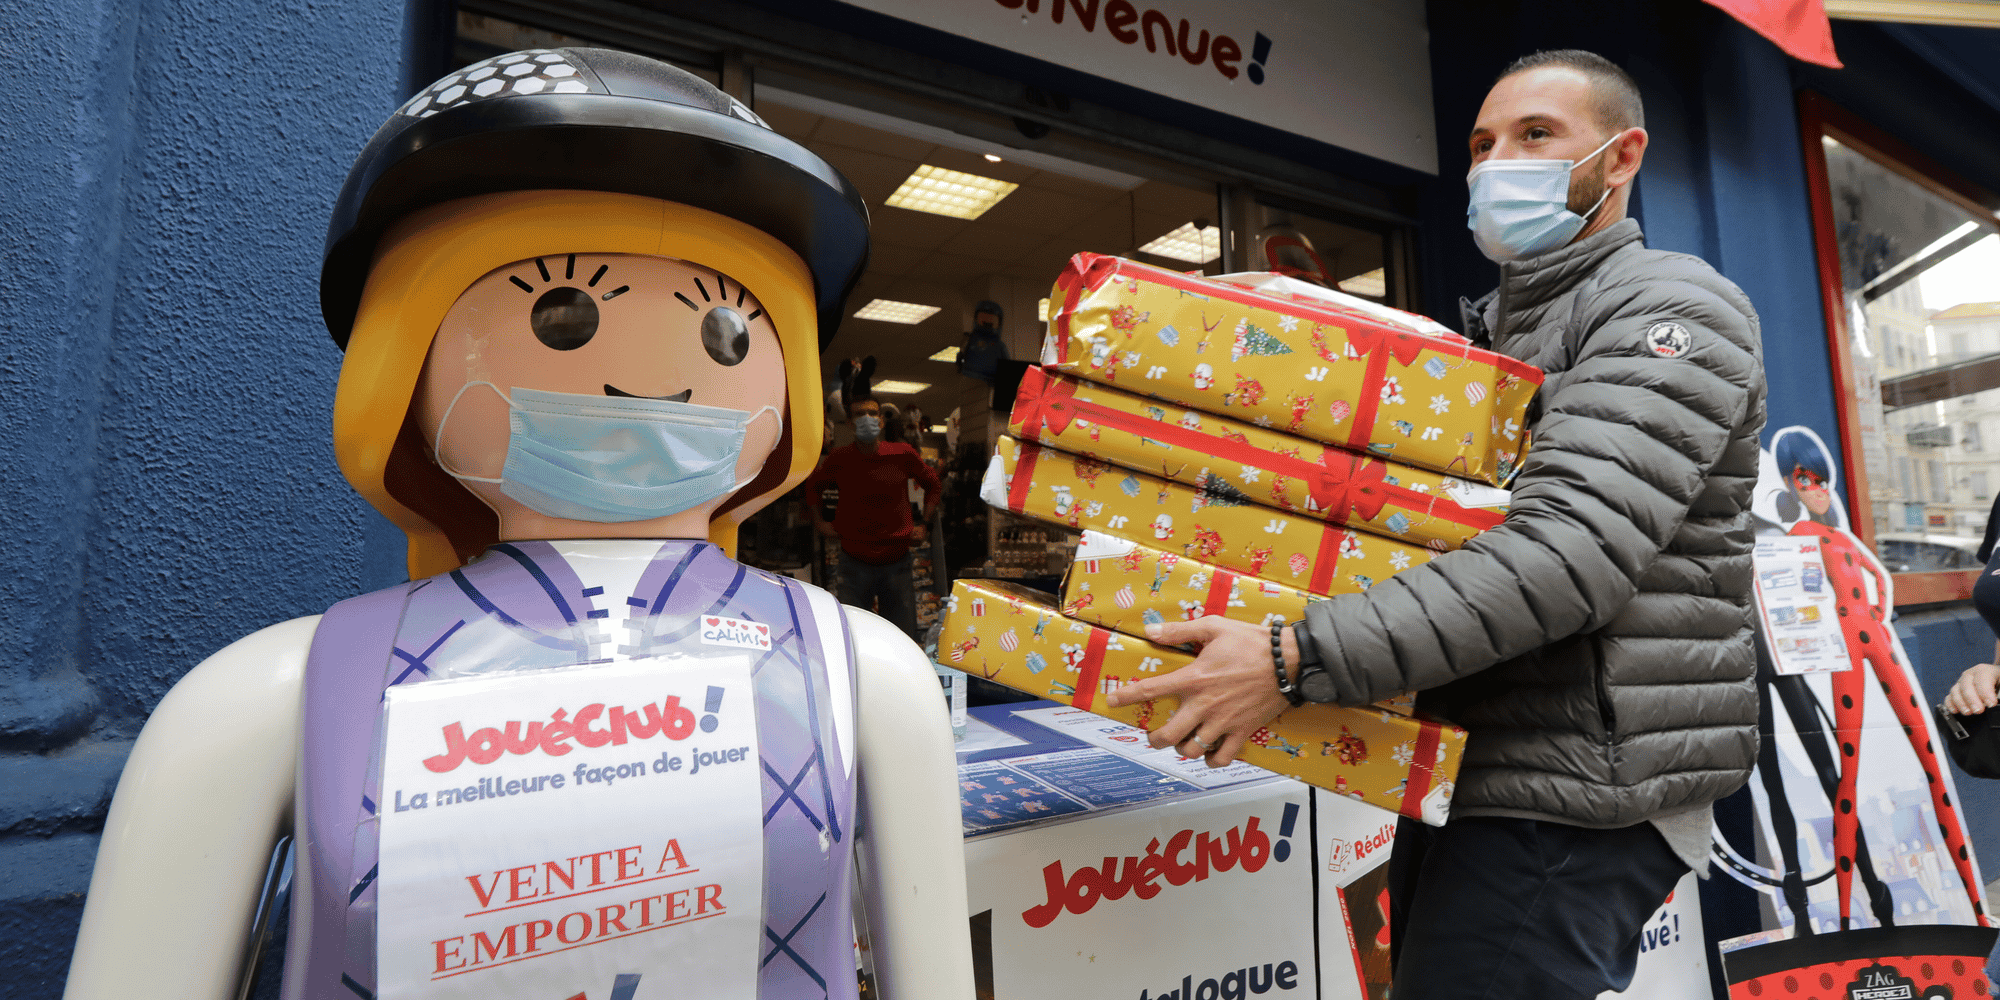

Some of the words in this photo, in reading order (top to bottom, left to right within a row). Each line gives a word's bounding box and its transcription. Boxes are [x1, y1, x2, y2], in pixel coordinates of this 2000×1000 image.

[394, 789, 428, 812] La
[436, 771, 566, 807] meilleure
[573, 762, 646, 787] façon
[653, 751, 683, 773] de
[690, 745, 750, 775] jouer
[466, 843, 644, 908] VENTE
[656, 838, 690, 875] A
[1354, 823, 1396, 861] Réalit
[431, 882, 727, 974] EMPORTER
[1864, 971, 1895, 988] ZAG
